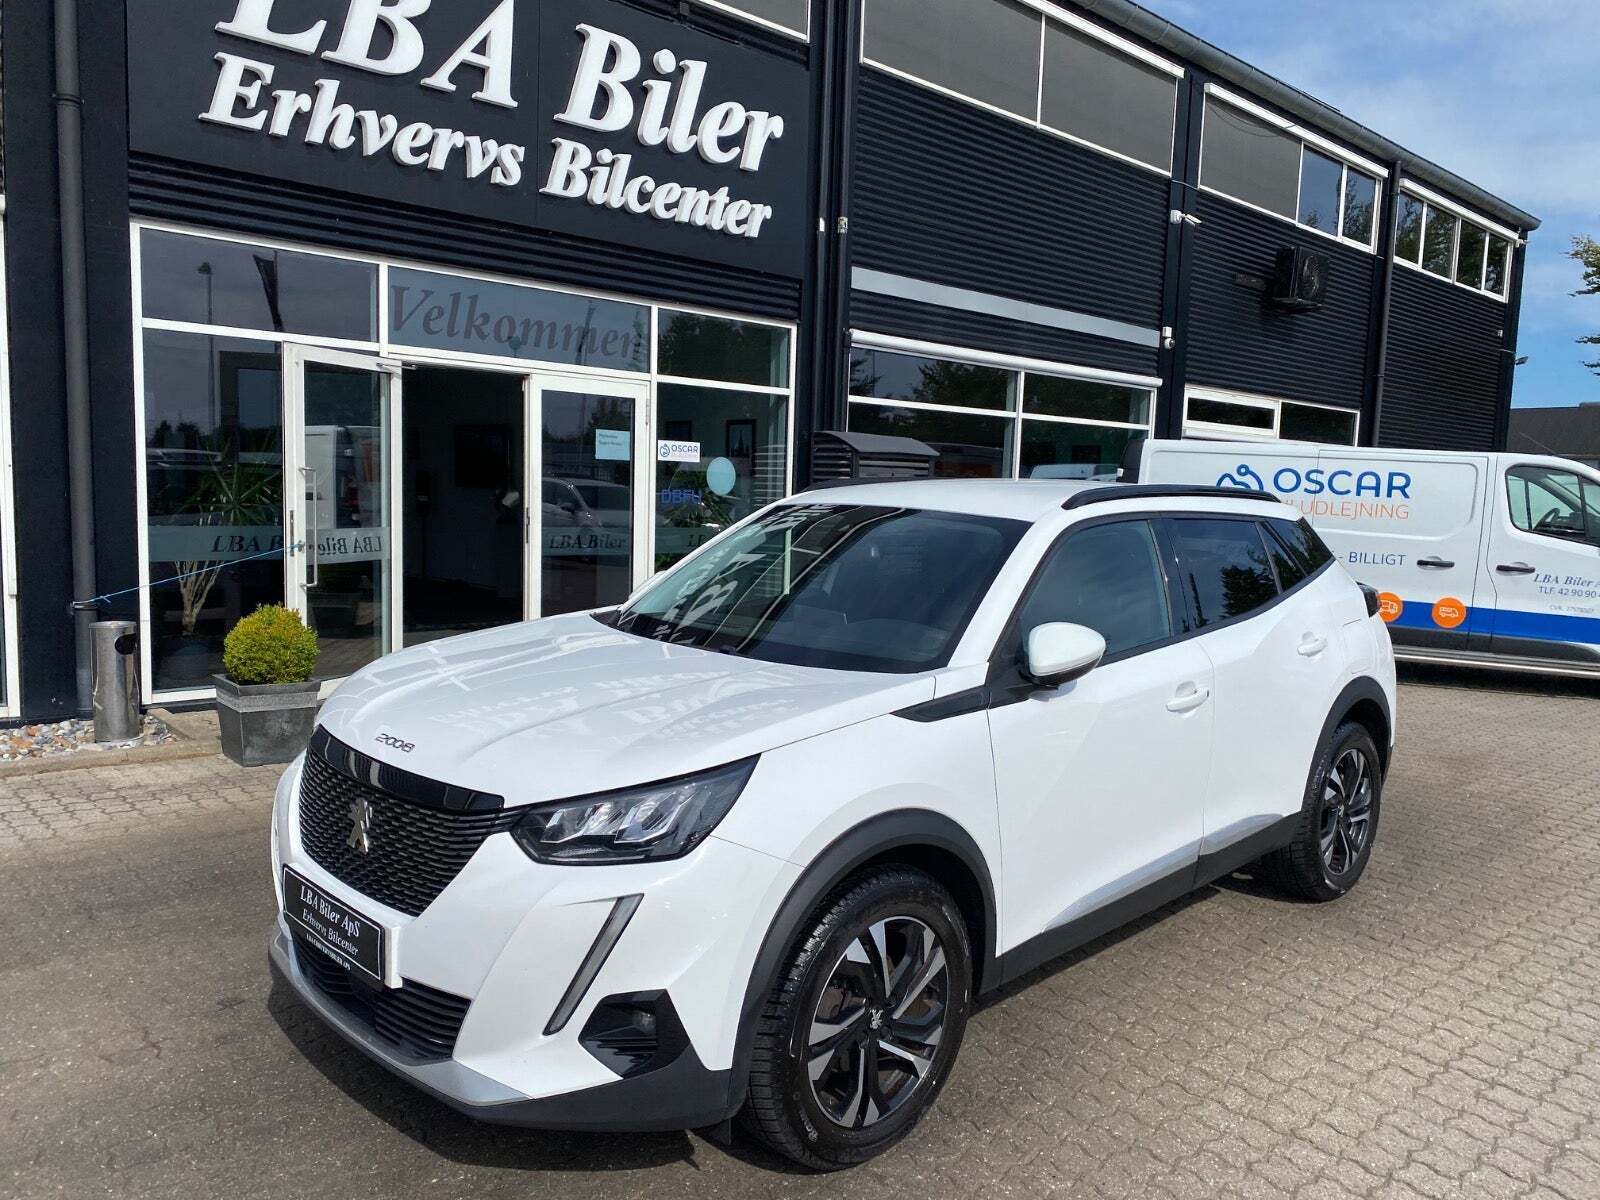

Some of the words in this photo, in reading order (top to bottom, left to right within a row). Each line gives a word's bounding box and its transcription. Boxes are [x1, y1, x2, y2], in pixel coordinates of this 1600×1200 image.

[553, 23, 784, 172] Biler
[198, 52, 525, 186] Erhvervs
[538, 137, 773, 238] Bilcenter
[390, 284, 643, 360] Velkommen
[671, 444, 699, 453] OSCAR
[1273, 466, 1413, 499] OSCAR
[212, 535, 261, 553] LBA
[550, 534, 583, 549] LBA
[586, 533, 626, 549] Biler
[1348, 551, 1407, 566] BILLIGT
[1534, 573, 1559, 584] LBA
[1564, 575, 1594, 588] Biler
[1558, 587, 1570, 596] 42
[1585, 590, 1597, 599] 90
[375, 732, 416, 753] 2008
[300, 885, 318, 909] LBA
[319, 898, 341, 924] Biler
[341, 915, 361, 938] ApS
[328, 928, 359, 956] Bilcenter
